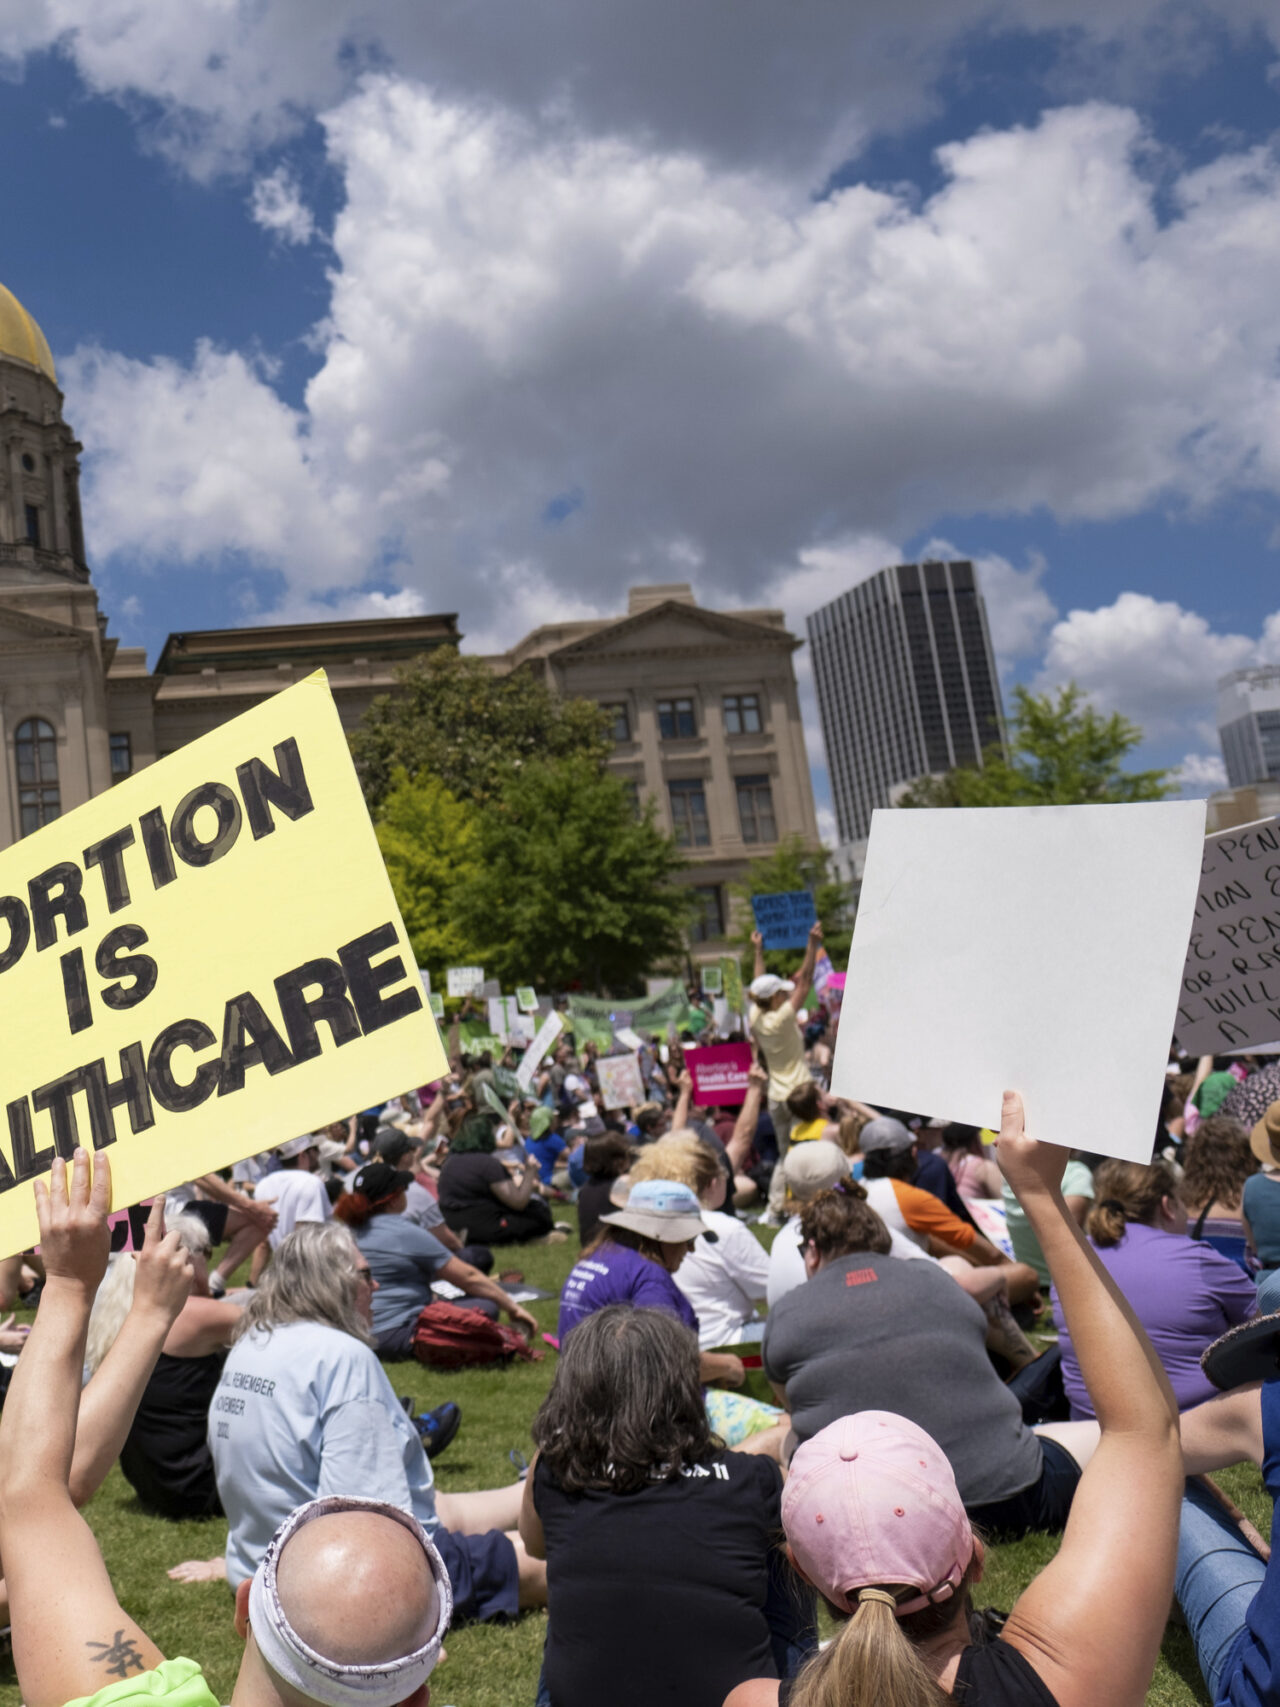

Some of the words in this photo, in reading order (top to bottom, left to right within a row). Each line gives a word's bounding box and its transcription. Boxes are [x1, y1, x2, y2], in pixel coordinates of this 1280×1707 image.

[1217, 825, 1280, 862] PEN
[60, 923, 158, 1035] IS
[1203, 981, 1280, 1014] WILL
[1218, 1020, 1249, 1045] A
[233, 1371, 276, 1398] REMEMBER
